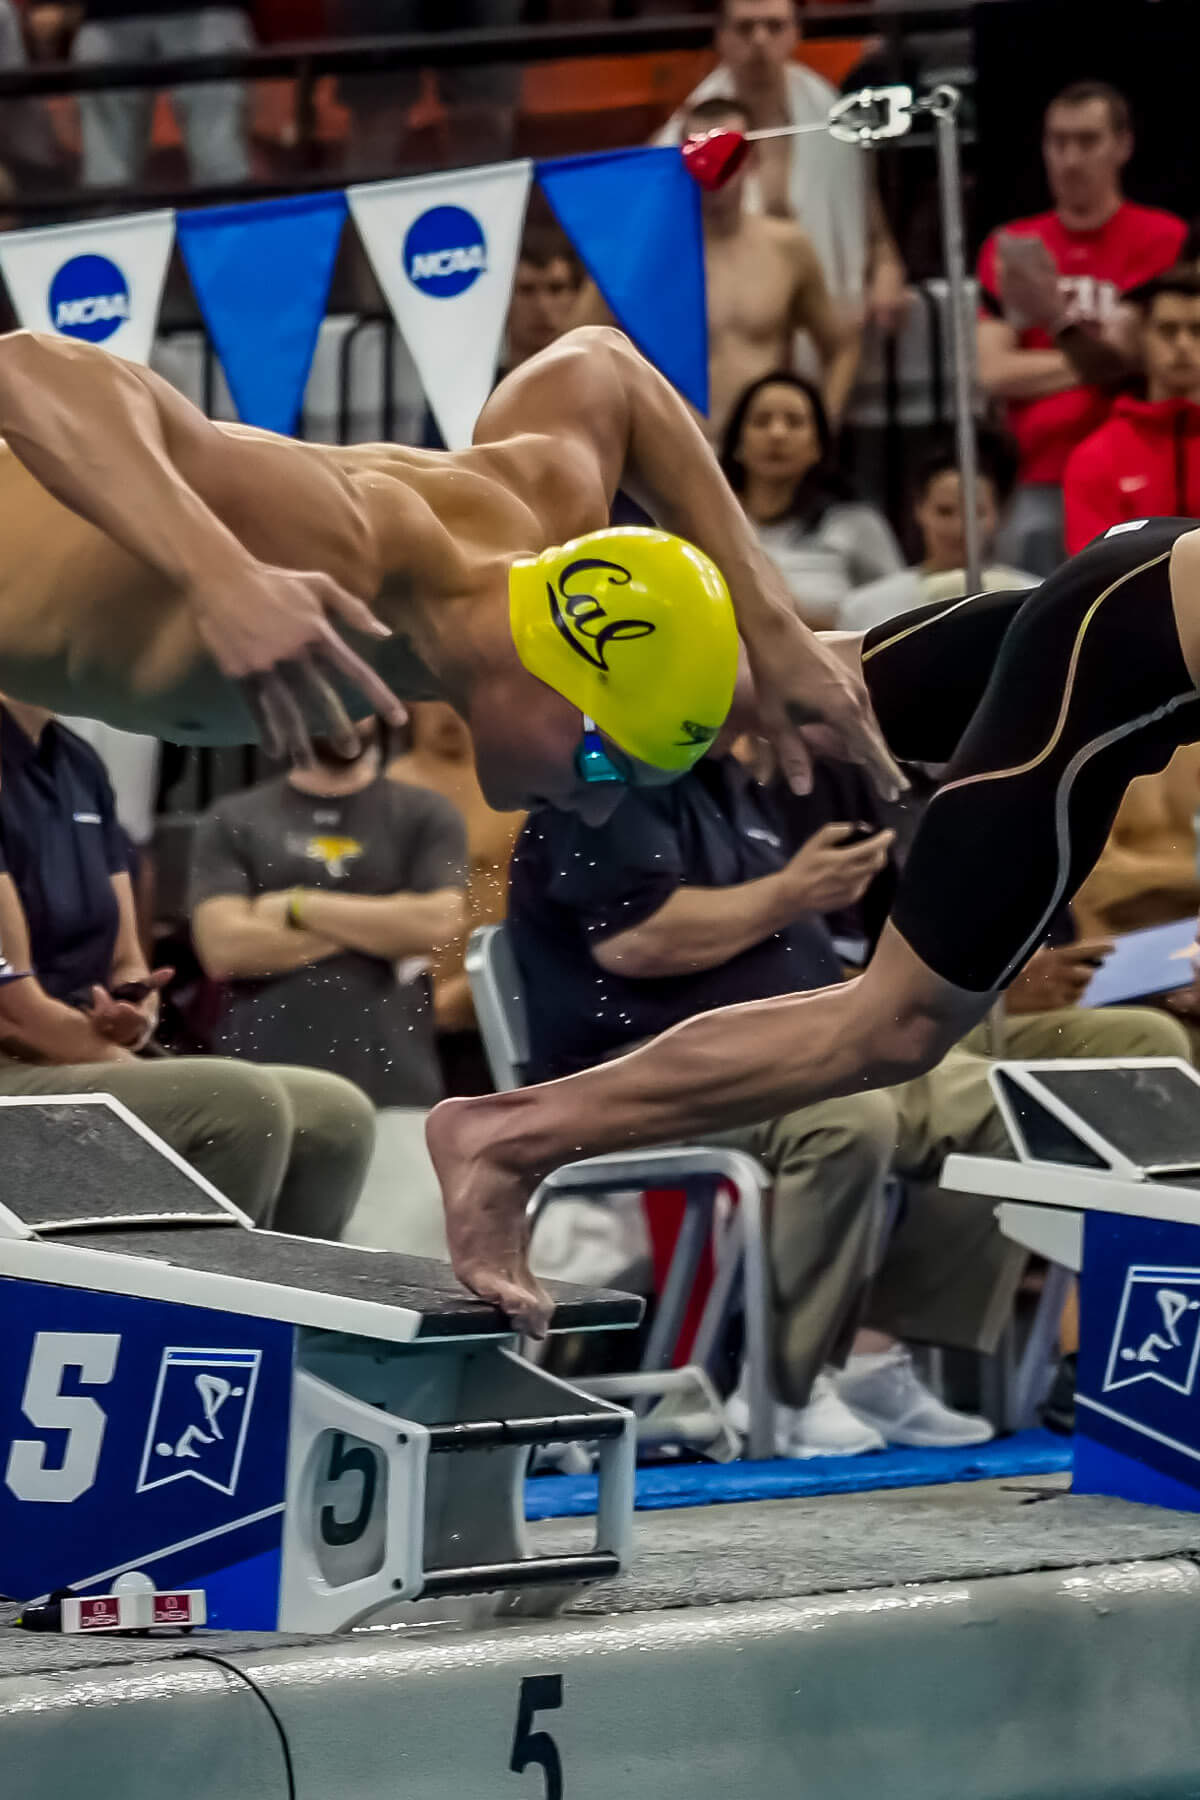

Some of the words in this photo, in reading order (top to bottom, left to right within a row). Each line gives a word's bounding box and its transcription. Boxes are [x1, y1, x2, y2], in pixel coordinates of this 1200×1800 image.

[411, 244, 487, 281] NCAA
[56, 293, 130, 328] NCAA
[547, 559, 656, 672] Cal
[5, 1332, 122, 1502] 5
